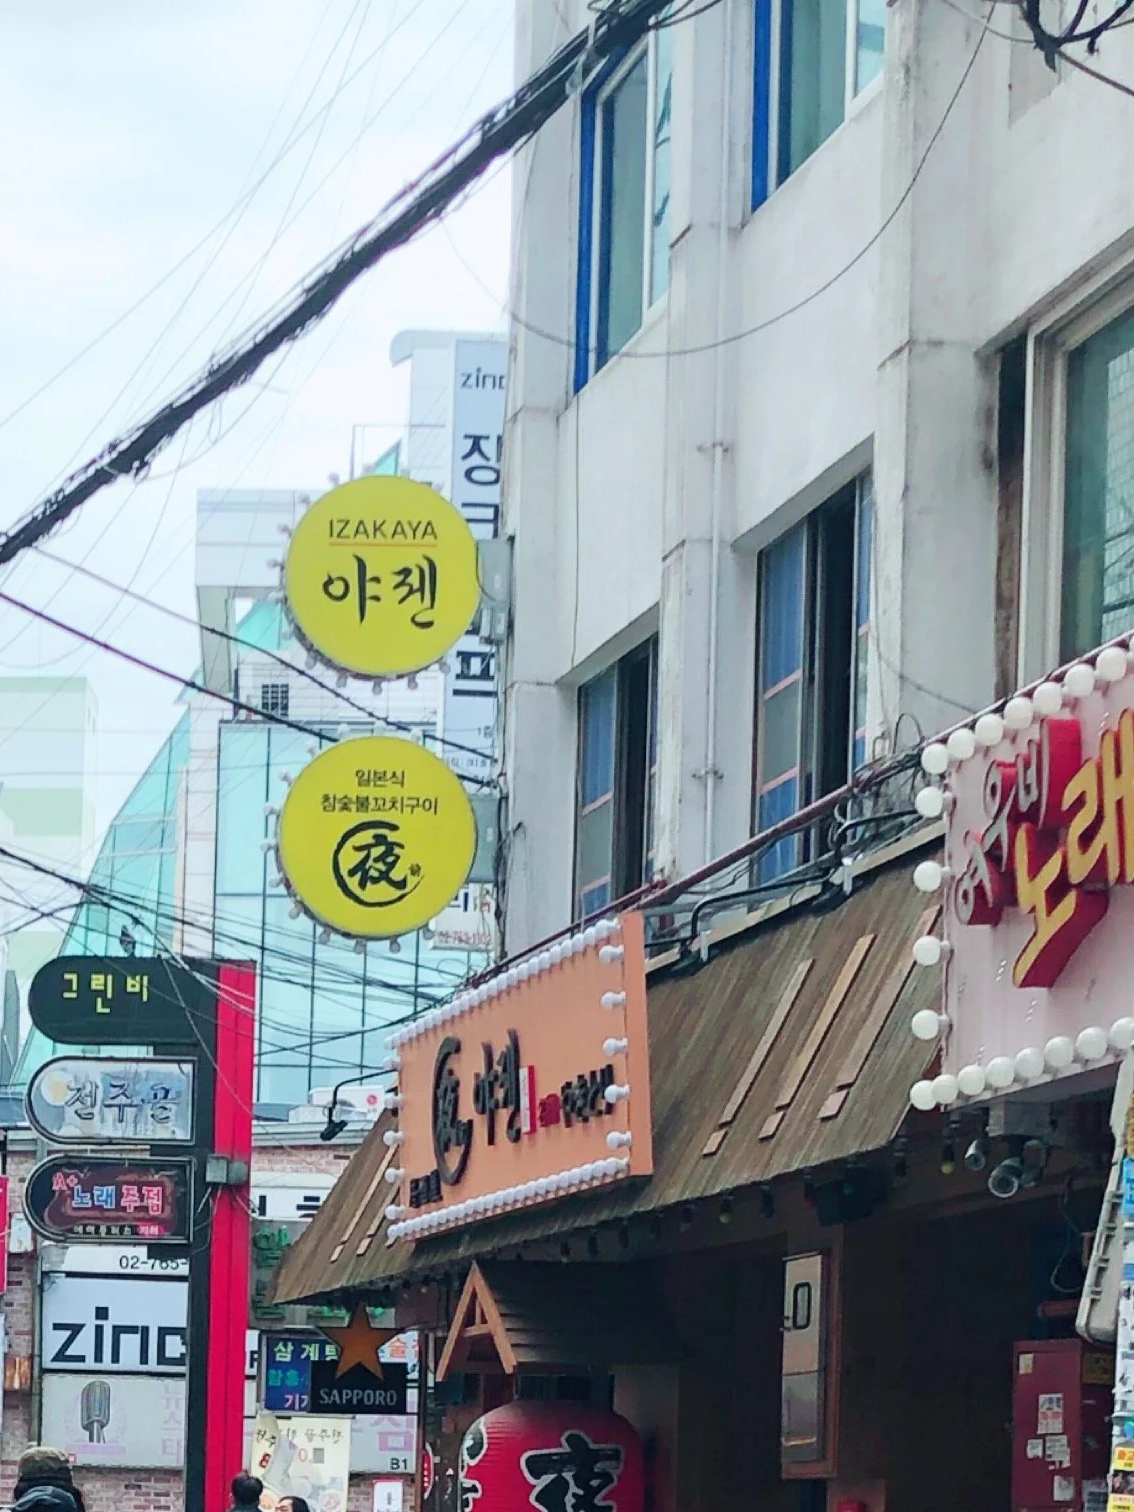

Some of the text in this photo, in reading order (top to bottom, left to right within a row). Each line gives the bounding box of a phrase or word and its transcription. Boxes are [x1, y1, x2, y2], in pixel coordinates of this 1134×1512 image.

[328, 518, 438, 541] IZAKAYA
[354, 769, 406, 789] 일본식
[62, 971, 150, 1014] 그린비
[50, 1305, 188, 1367] zinc
[319, 1388, 398, 1406] SAPPORO
[389, 1457, 409, 1471] B1
